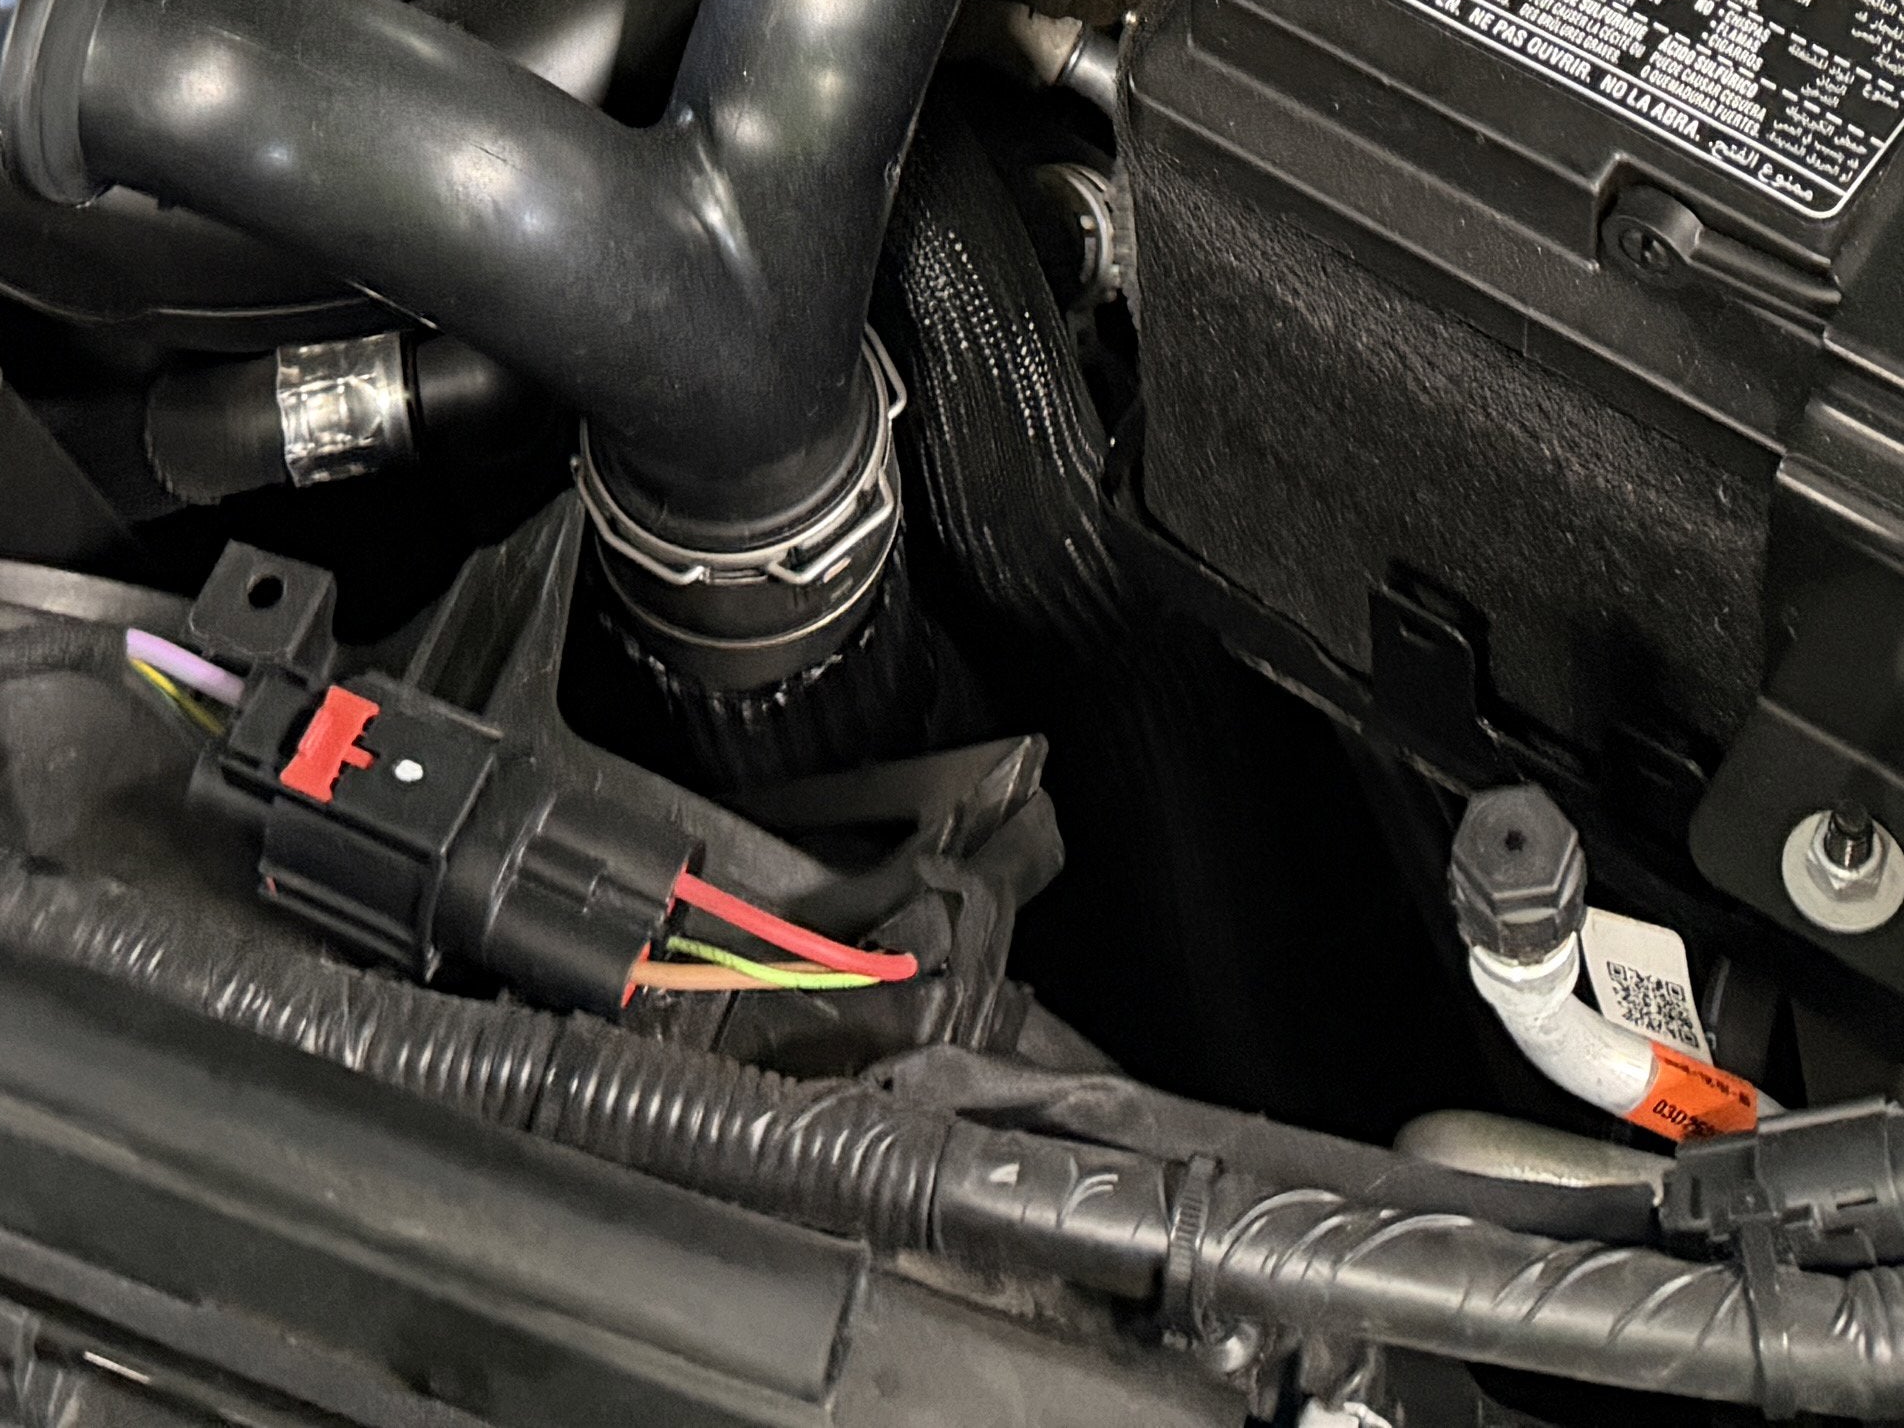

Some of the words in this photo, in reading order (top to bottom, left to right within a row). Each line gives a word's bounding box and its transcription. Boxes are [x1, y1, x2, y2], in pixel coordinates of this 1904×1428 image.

[1517, 2, 1546, 24] DES
[1549, 1, 1590, 28] CAUSER
[1584, 19, 1602, 35] LA
[1626, 41, 1647, 59] OU
[1721, 10, 1774, 43] CHISPAS
[1466, 6, 1497, 31] NE
[1489, 18, 1529, 48] PAS
[1523, 36, 1598, 84] OUVRIR.
[1704, 33, 1766, 72] CIGARROS
[1713, 22, 1763, 53] FLAMAS
[1646, 50, 1685, 78] PUEDE
[1678, 67, 1724, 98] CAUSAR
[1646, 69, 1719, 114] QUEMADURAS
[1596, 73, 1631, 100] NO
[1623, 87, 1655, 113] LA
[1647, 100, 1709, 142] ABRA.
